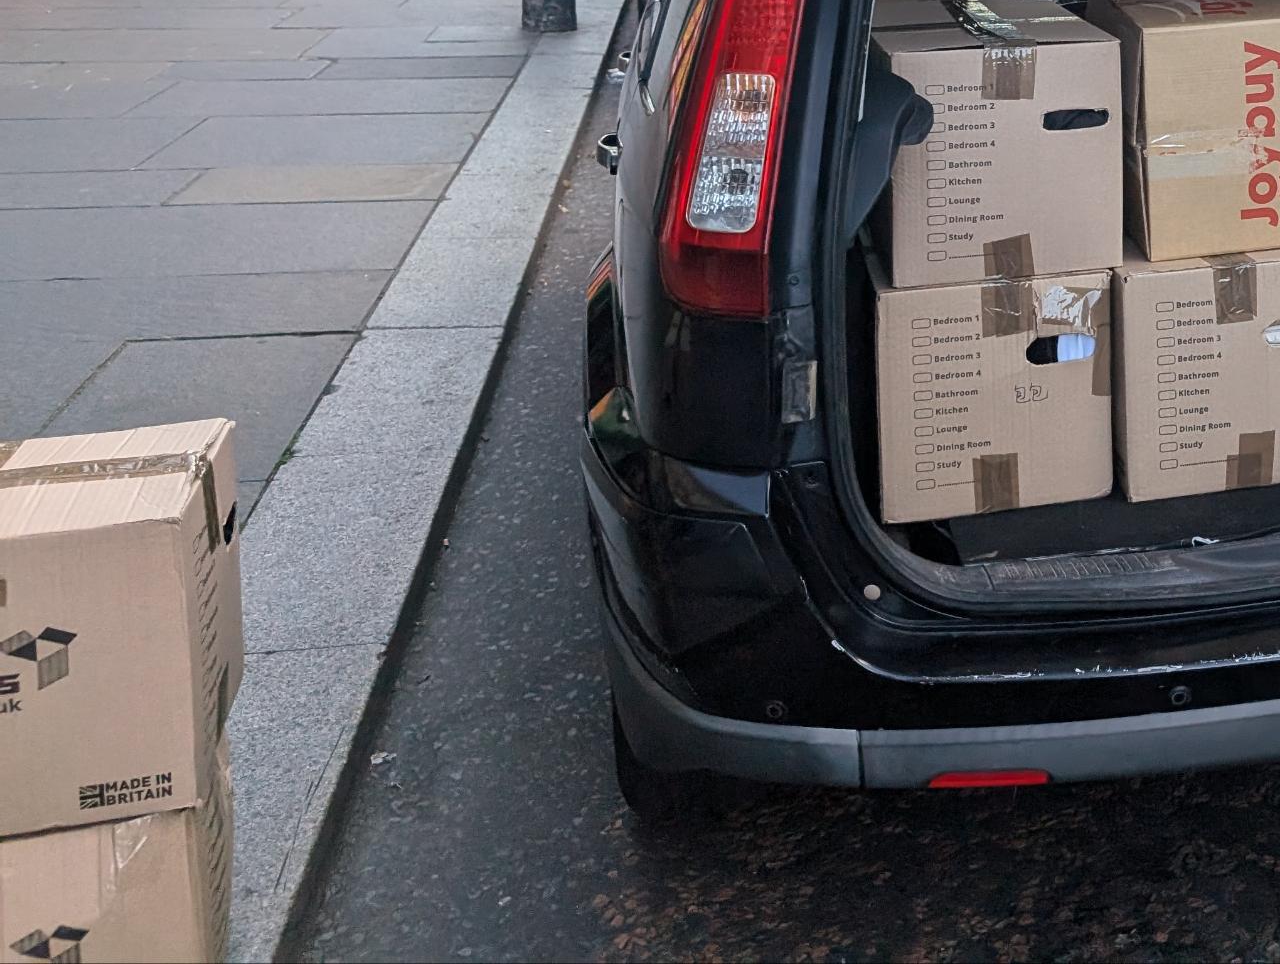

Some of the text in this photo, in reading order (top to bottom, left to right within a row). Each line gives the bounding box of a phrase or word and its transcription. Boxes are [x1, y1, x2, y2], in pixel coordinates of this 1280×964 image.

[947, 84, 987, 93] Bedroom
[947, 102, 996, 112] Bedroom 2
[948, 123, 988, 131] Bedroom
[948, 140, 996, 150] Bedroom 4
[948, 159, 993, 169] Bathroom
[948, 177, 982, 186] Kitchen
[948, 196, 981, 206] Lounge
[949, 213, 1004, 224] Dining Room
[948, 232, 974, 242] Study
[1176, 299, 1213, 309] Bedroom
[933, 316, 972, 326] Bedroom
[1176, 317, 1214, 327] Bedroom
[933, 333, 981, 344] Bedroom 2
[1177, 336, 1215, 345] Bedroom
[934, 353, 974, 363] Bedroom
[1177, 353, 1215, 363] Bedroom
[935, 369, 982, 380] Bedroom 4
[1178, 371, 1219, 381] Bathroom
[935, 389, 979, 399] Bathroom
[1178, 387, 1210, 397] Kitchen
[935, 406, 969, 416] Kitchen
[1178, 405, 1209, 415] Lounge
[936, 424, 968, 434] Lounge
[1179, 421, 1232, 433] Dining Room
[936, 439, 991, 452] Dining Room
[1179, 441, 1203, 449] Study
[936, 460, 962, 469] Study
[105, 772, 172, 793] MADE IN
[106, 785, 173, 806] BRITAIN
